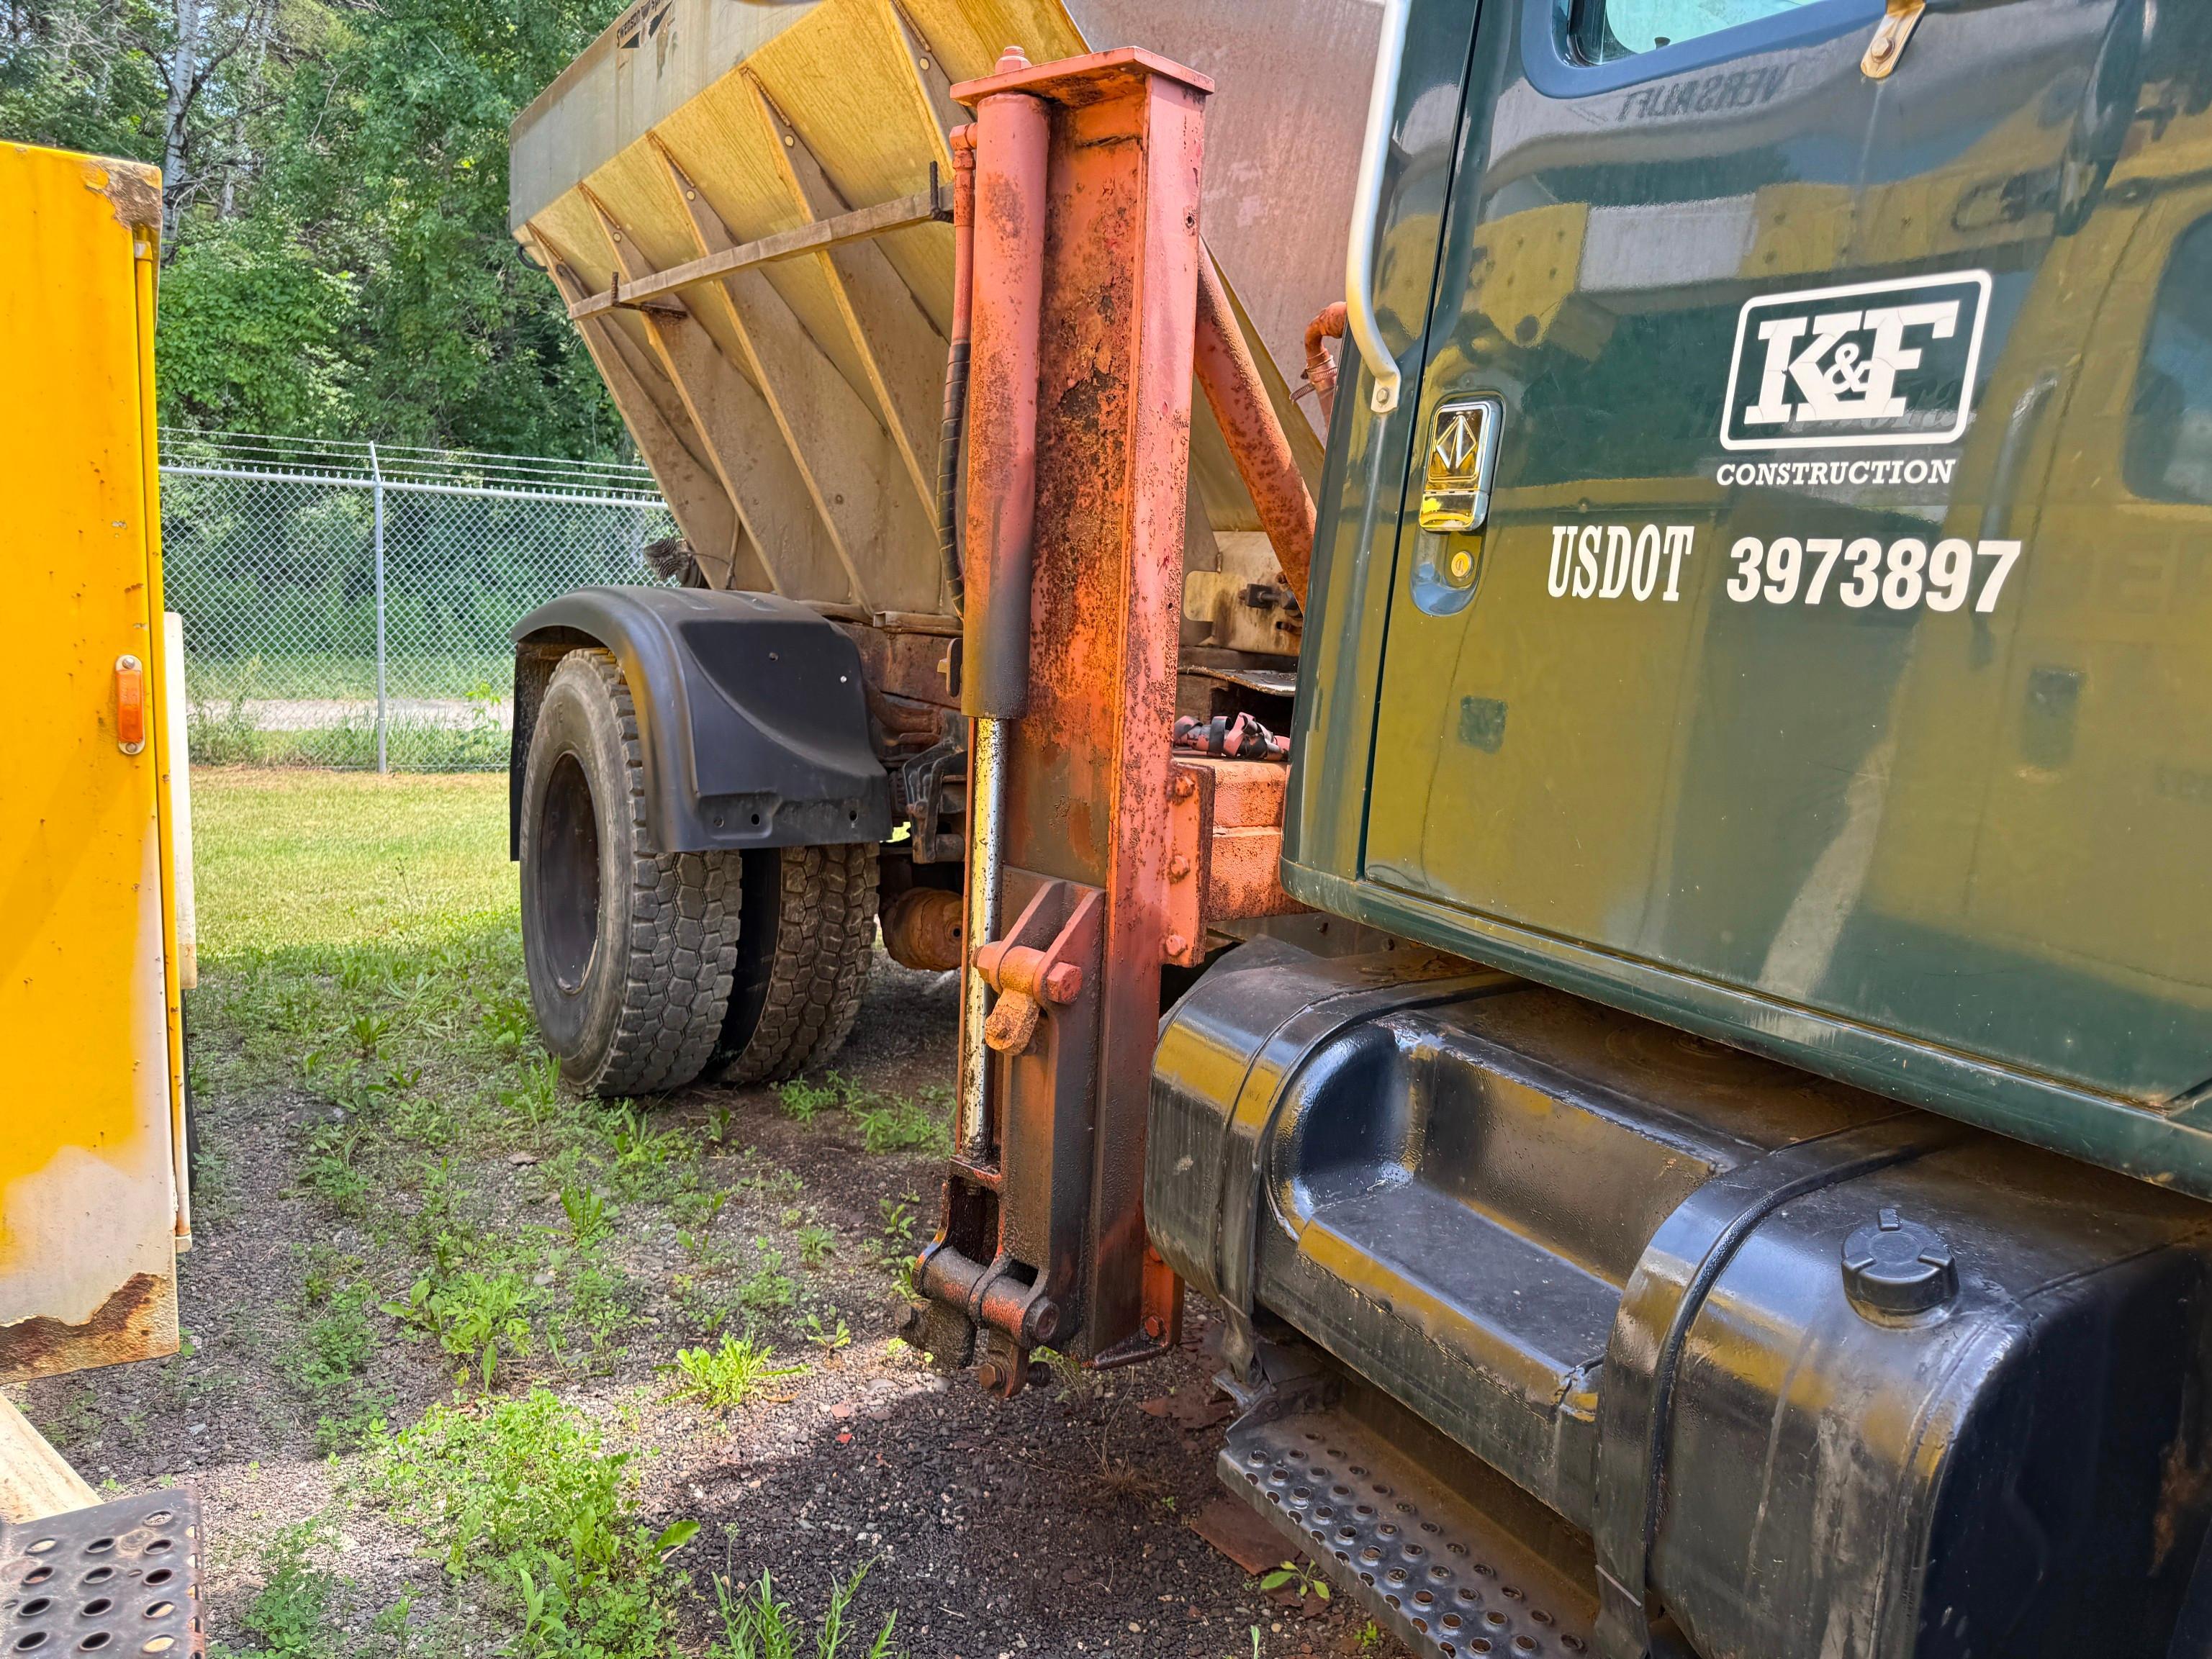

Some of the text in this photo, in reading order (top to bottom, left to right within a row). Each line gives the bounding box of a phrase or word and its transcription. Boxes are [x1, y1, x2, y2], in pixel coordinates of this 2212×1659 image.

[1744, 300, 1961, 425] K&F
[1716, 458, 1956, 487] CONSTRUCTION
[1548, 524, 2021, 612] USDOT 3973897
